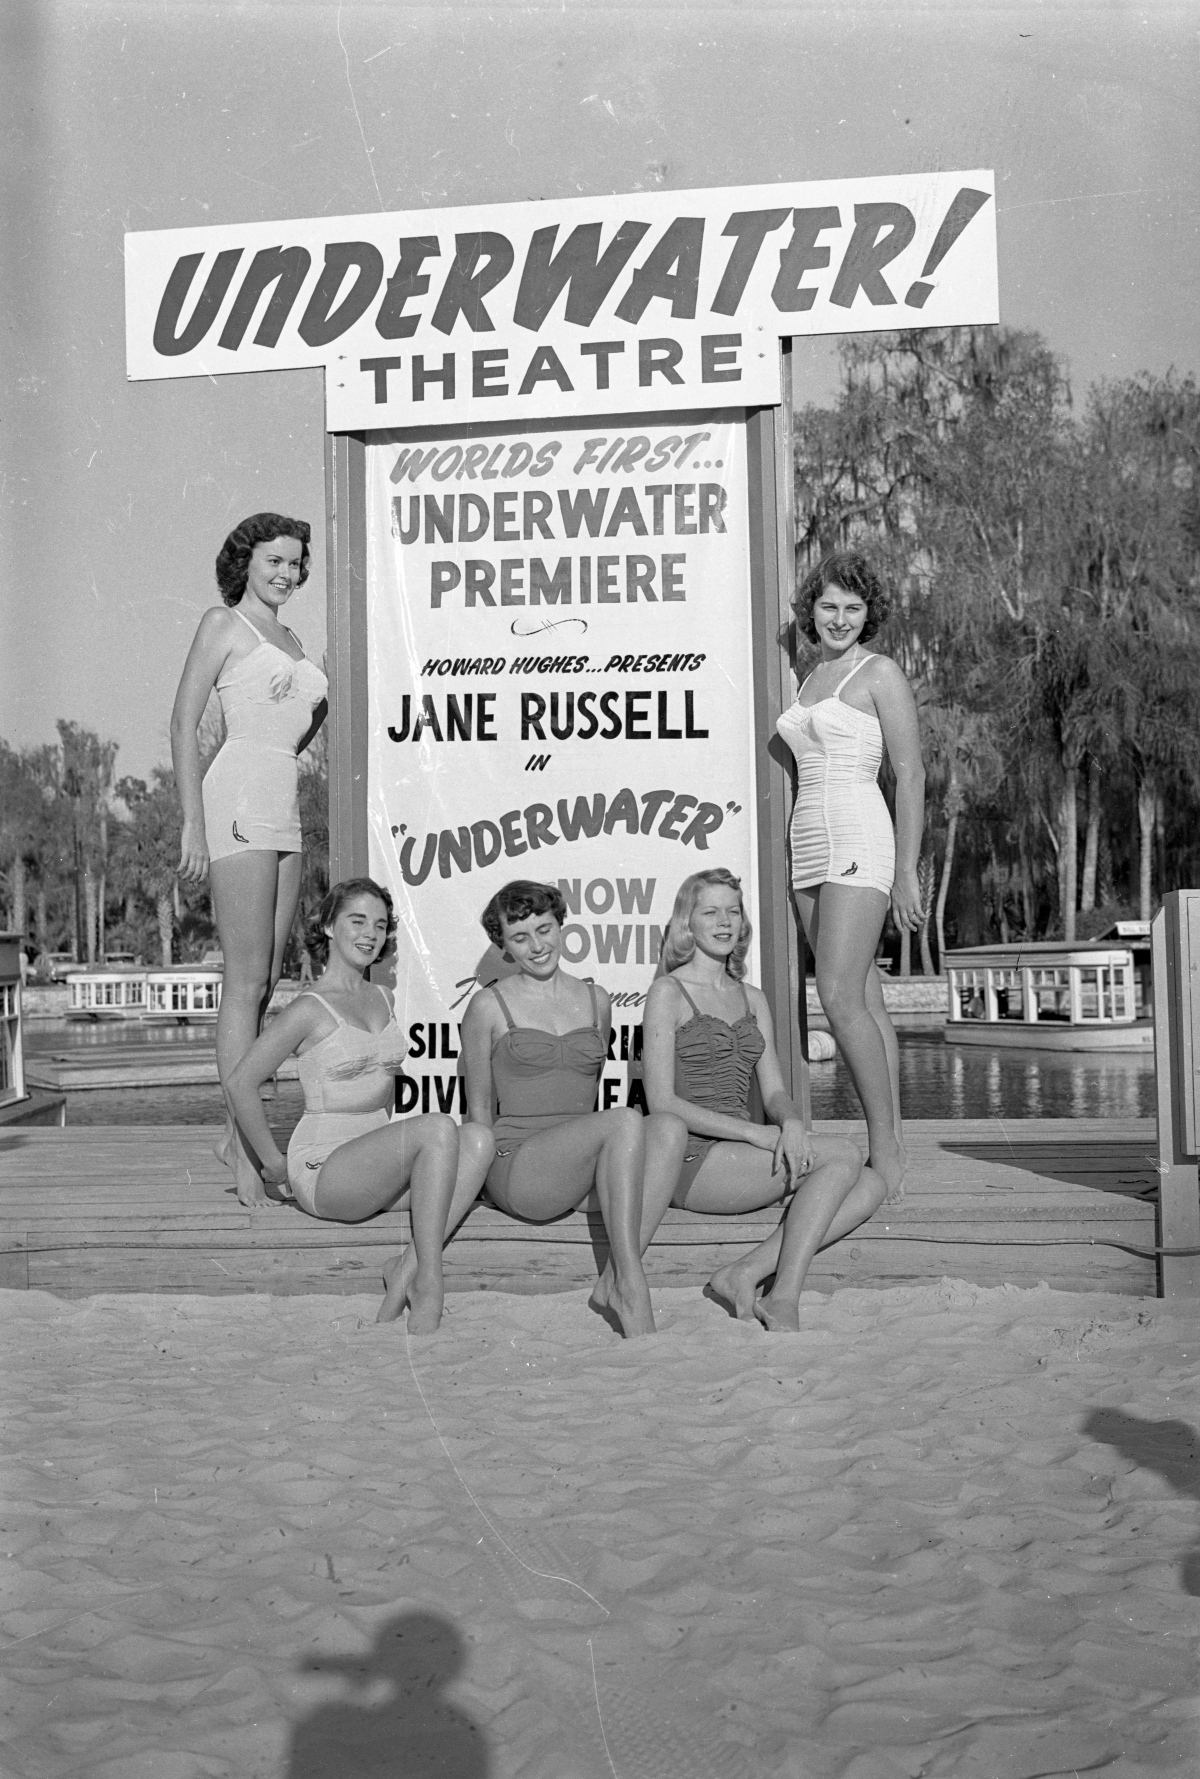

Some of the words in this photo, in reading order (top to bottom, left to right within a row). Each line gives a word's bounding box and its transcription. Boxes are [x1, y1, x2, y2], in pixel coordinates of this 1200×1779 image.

[153, 188, 991, 356] UNDERWATER!
[360, 333, 743, 404] THEATRE
[390, 441, 562, 484] WORLDS
[573, 432, 723, 475] FIRST...
[391, 483, 728, 545] UNDERWATER
[431, 553, 686, 608] PREMIERE
[421, 657, 506, 676] HOWARD
[388, 693, 498, 743] JANE
[521, 690, 709, 741] RUSSELL
[525, 754, 551, 772] IN
[391, 788, 743, 886] "UNDERWATER"
[558, 878, 657, 915] NOW
[408, 1022, 461, 1059] SIL
[395, 1074, 467, 1114] DIVI
